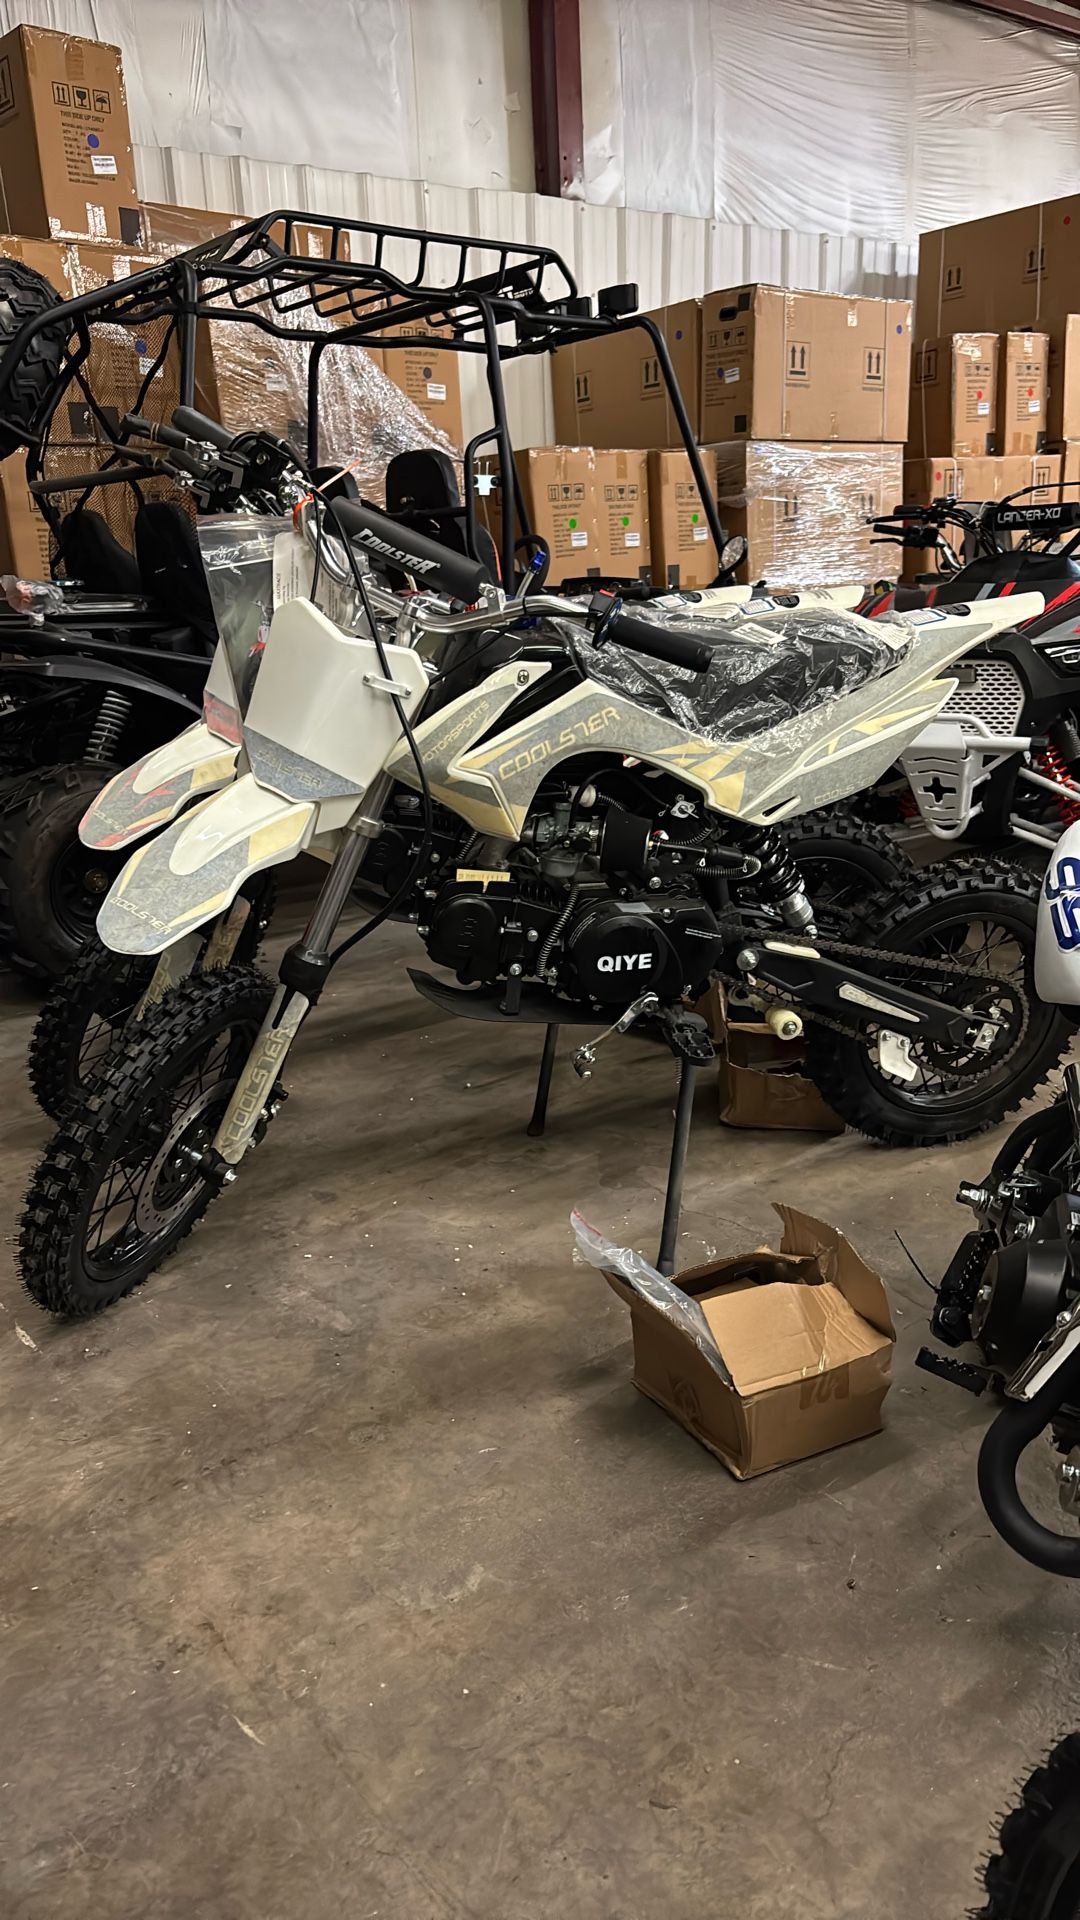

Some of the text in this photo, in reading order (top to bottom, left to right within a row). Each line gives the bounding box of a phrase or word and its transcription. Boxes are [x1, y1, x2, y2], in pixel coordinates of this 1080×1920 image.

[499, 706, 621, 780] COOLSTER
[110, 896, 172, 935] COOLSTER
[597, 953, 652, 973] QIYE
